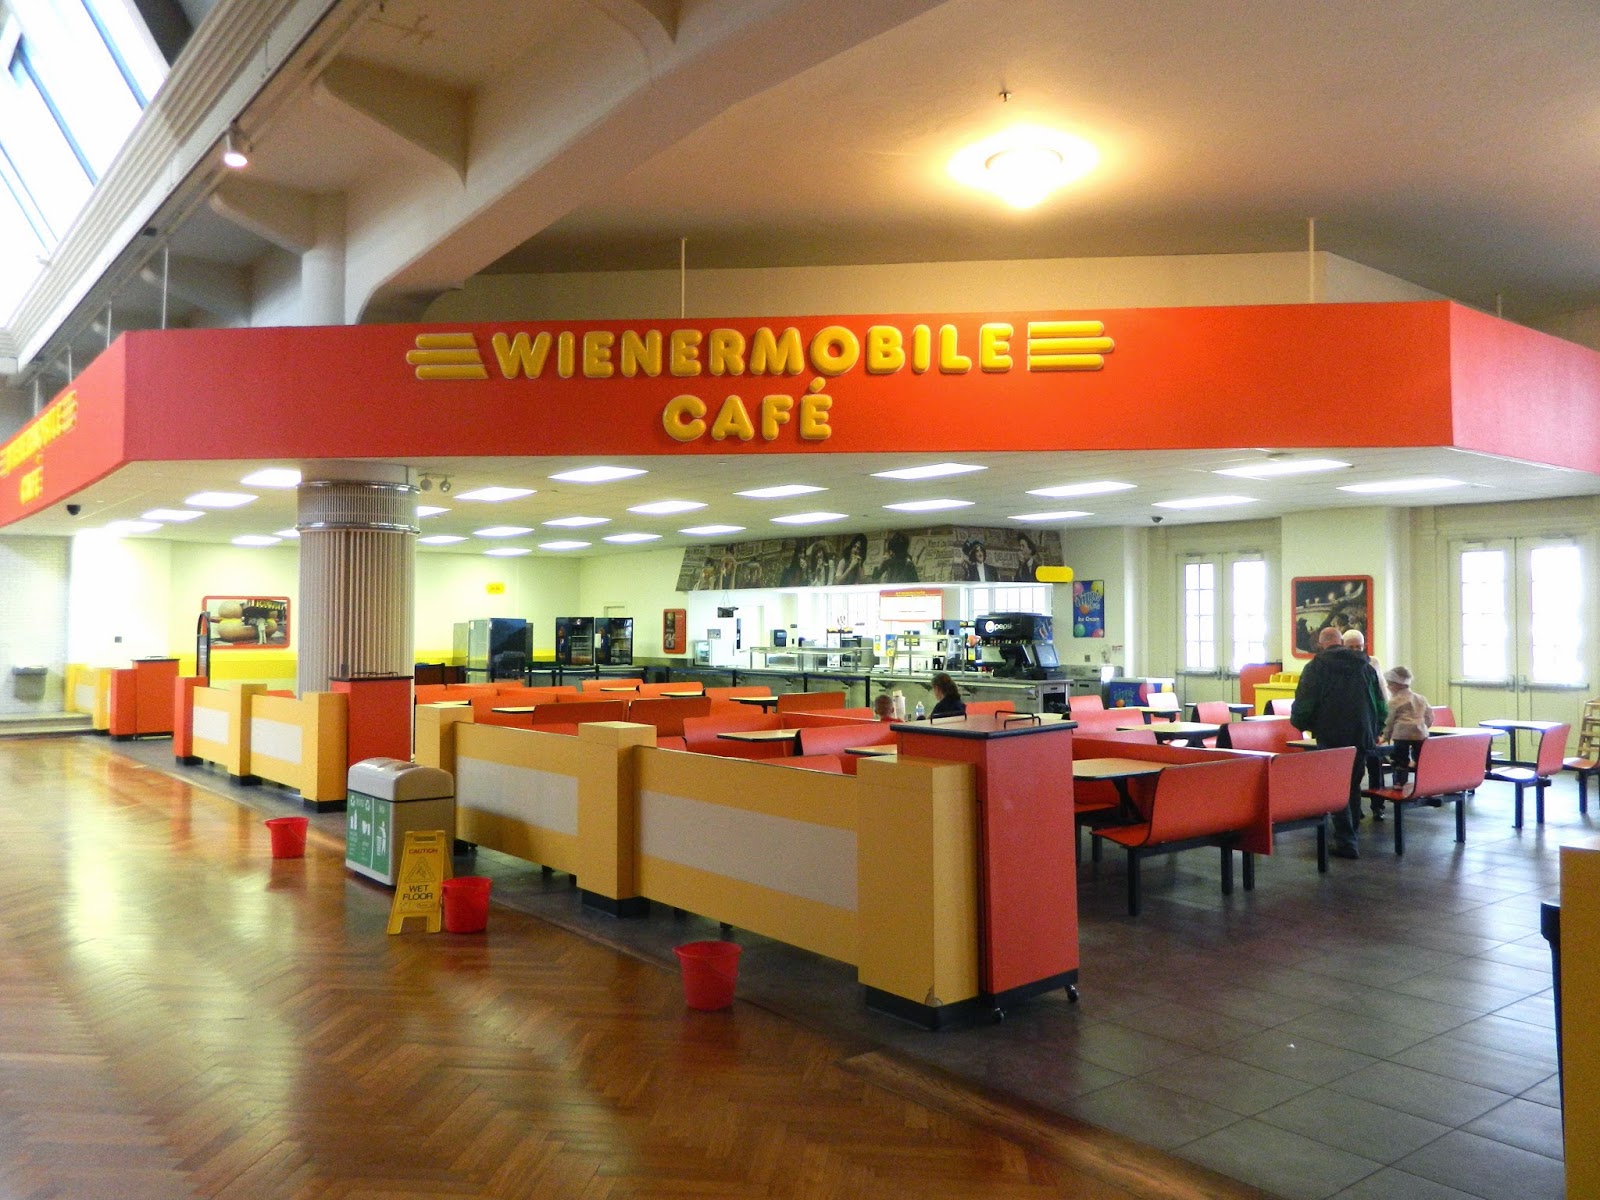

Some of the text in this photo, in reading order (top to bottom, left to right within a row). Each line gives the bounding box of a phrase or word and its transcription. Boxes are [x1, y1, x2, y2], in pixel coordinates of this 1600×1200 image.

[490, 322, 1014, 379] WIENERMOBILE
[662, 376, 834, 442] CAFÉ
[402, 892, 433, 901] FLOOR
[408, 884, 429, 893] WET
